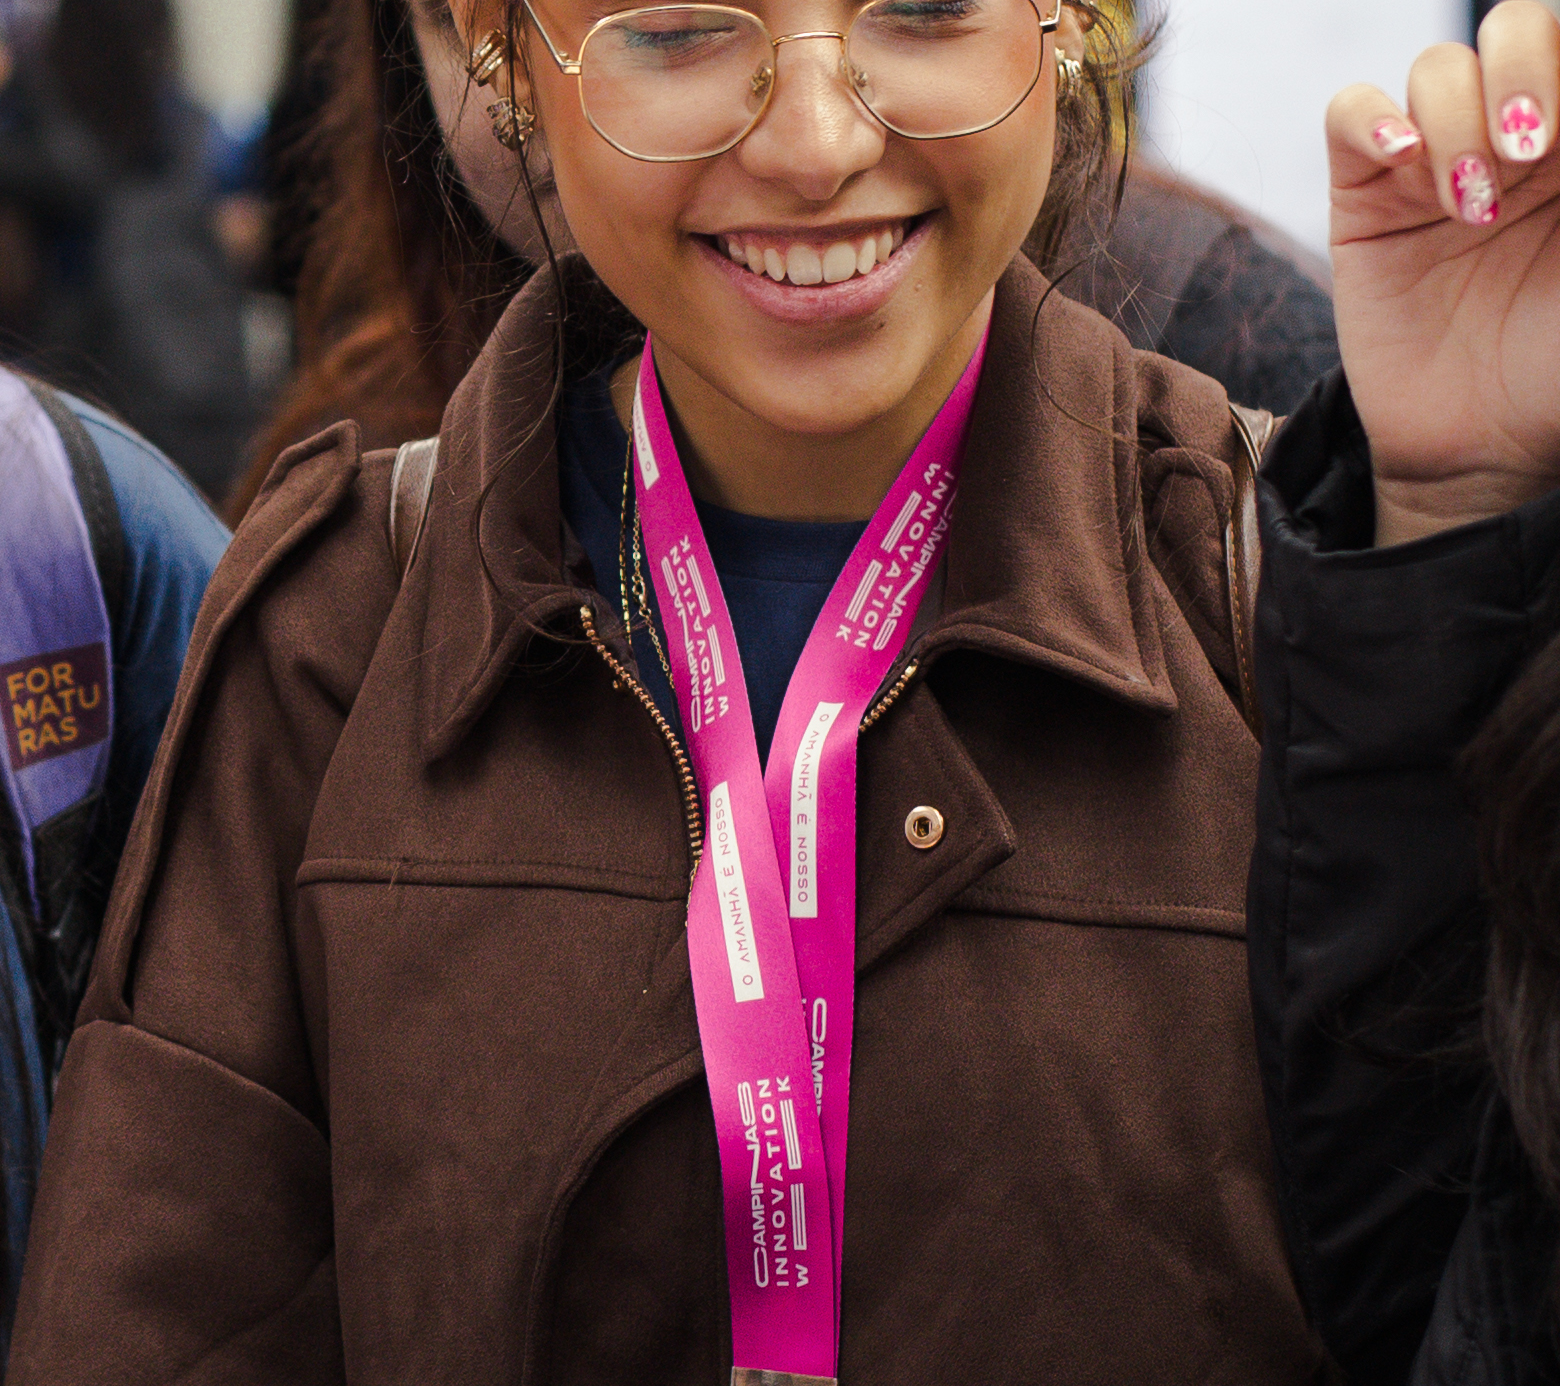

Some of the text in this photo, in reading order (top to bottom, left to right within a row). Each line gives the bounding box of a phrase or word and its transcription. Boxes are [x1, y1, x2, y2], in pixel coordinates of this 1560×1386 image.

[854, 470, 955, 649] INNOVATION
[661, 555, 702, 733] CAMPINAS
[670, 545, 715, 725] INNOVATION
[6, 661, 75, 701] FOR
[12, 683, 101, 729] MATU
[818, 712, 830, 723] O
[18, 715, 78, 757] RAS
[796, 730, 820, 803] AMANHÃ
[714, 797, 731, 856] NOSSO
[796, 836, 809, 903] NOSSO
[723, 887, 751, 964] AMANHÃ
[741, 974, 753, 986] O
[737, 1081, 769, 1287] CAMPINAS
[757, 1078, 790, 1287] INNOVATION
[776, 1075, 809, 1287] WEEK
